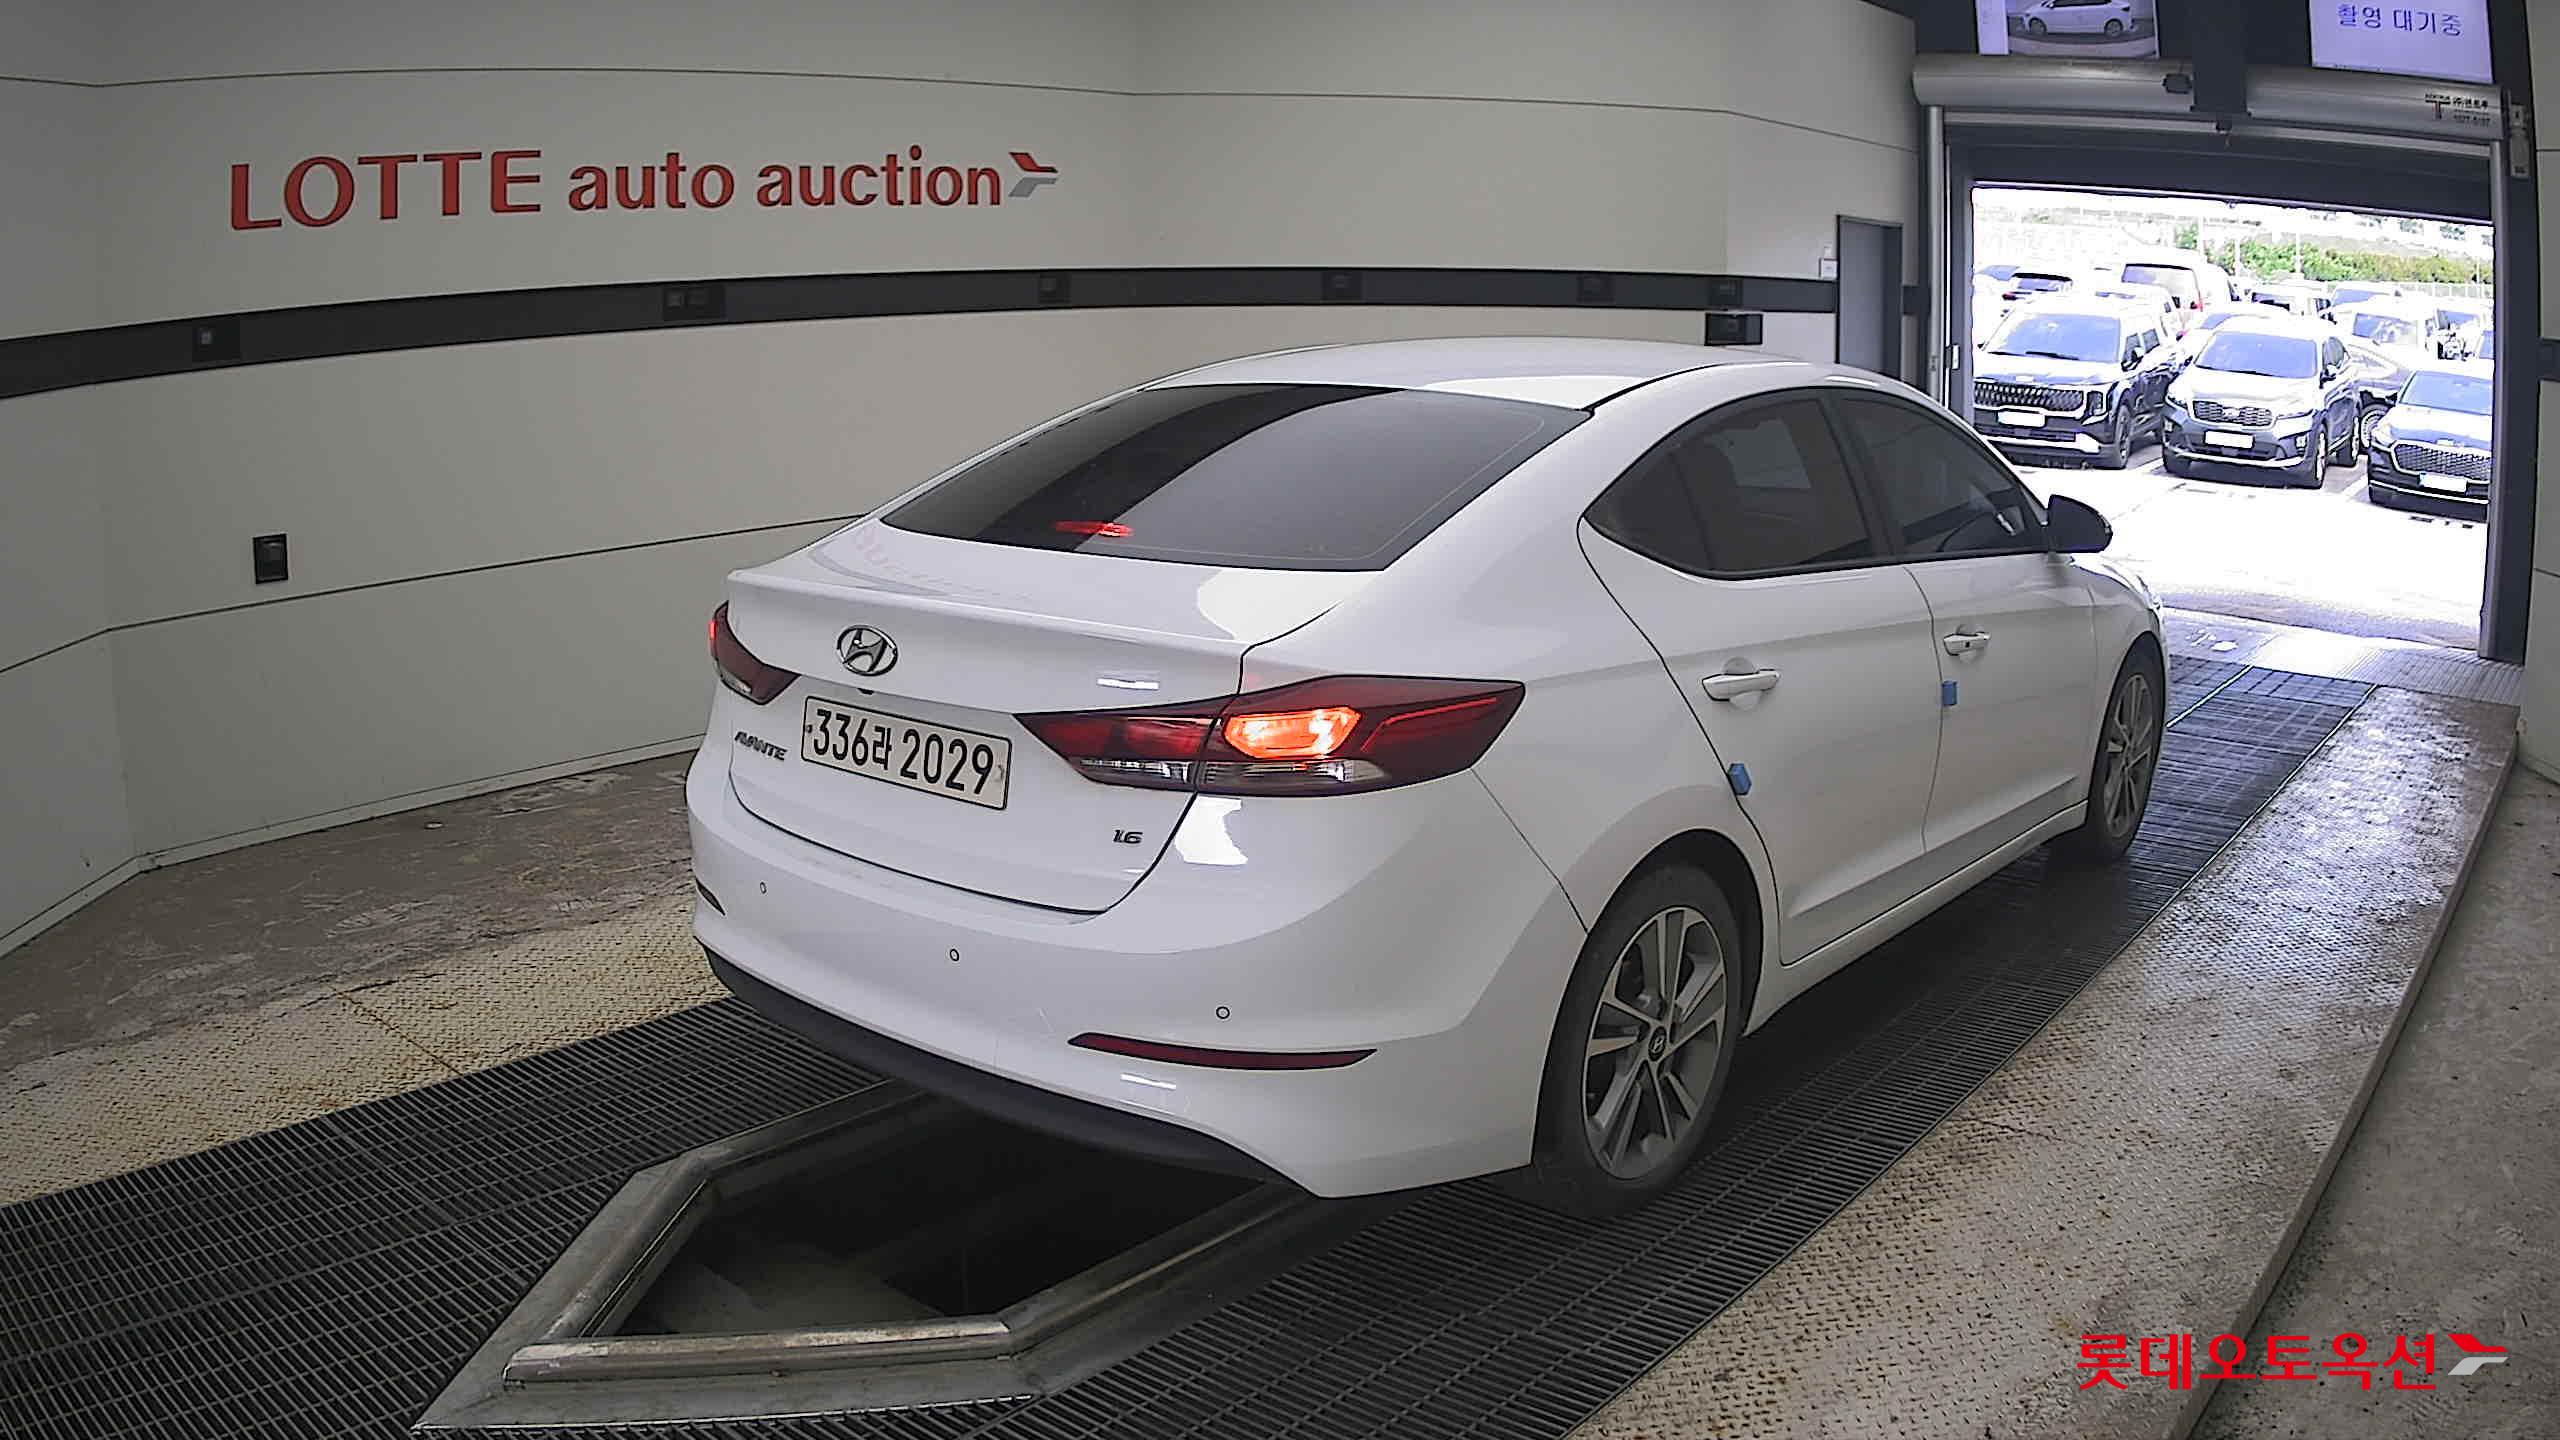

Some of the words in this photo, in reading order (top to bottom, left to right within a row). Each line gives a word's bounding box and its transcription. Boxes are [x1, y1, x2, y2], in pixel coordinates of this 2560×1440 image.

[2338, 3, 2382, 29] 촬영
[2393, 9, 2462, 37] 대기중
[231, 150, 541, 230] LOTTE
[568, 152, 735, 210] auto
[756, 146, 1002, 207] auction
[734, 731, 788, 761] AVANTE
[813, 708, 893, 770] 336라
[900, 728, 995, 795] 2029
